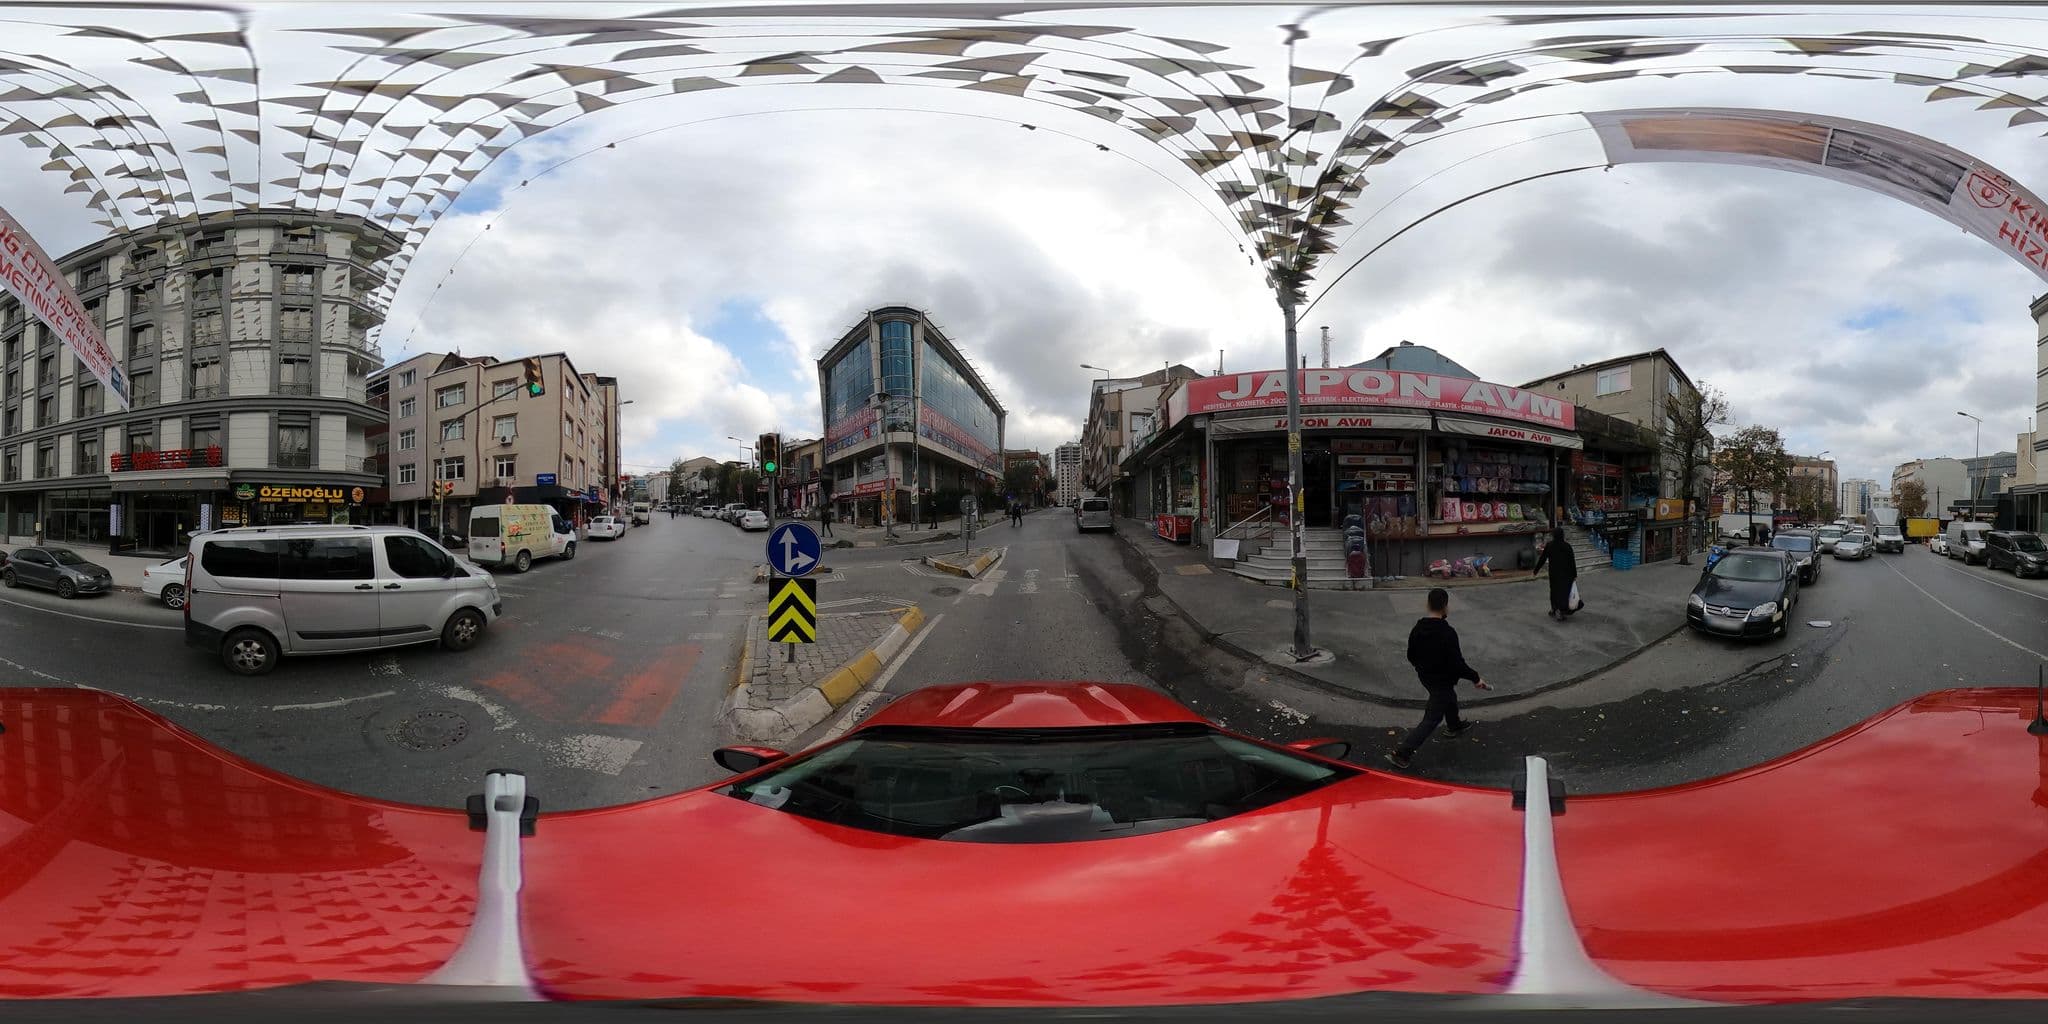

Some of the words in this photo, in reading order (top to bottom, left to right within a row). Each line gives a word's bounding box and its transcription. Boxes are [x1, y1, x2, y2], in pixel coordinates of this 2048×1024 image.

[21, 250, 55, 292] CITY
[56, 288, 85, 338] HOTEL
[1218, 373, 1440, 400] JAPON
[1461, 383, 1561, 418] AVM
[1337, 418, 1372, 427] AVM
[1488, 427, 1525, 439] JAPON
[1531, 432, 1552, 443] AVM
[260, 486, 343, 498] ÖZENOĞLU
